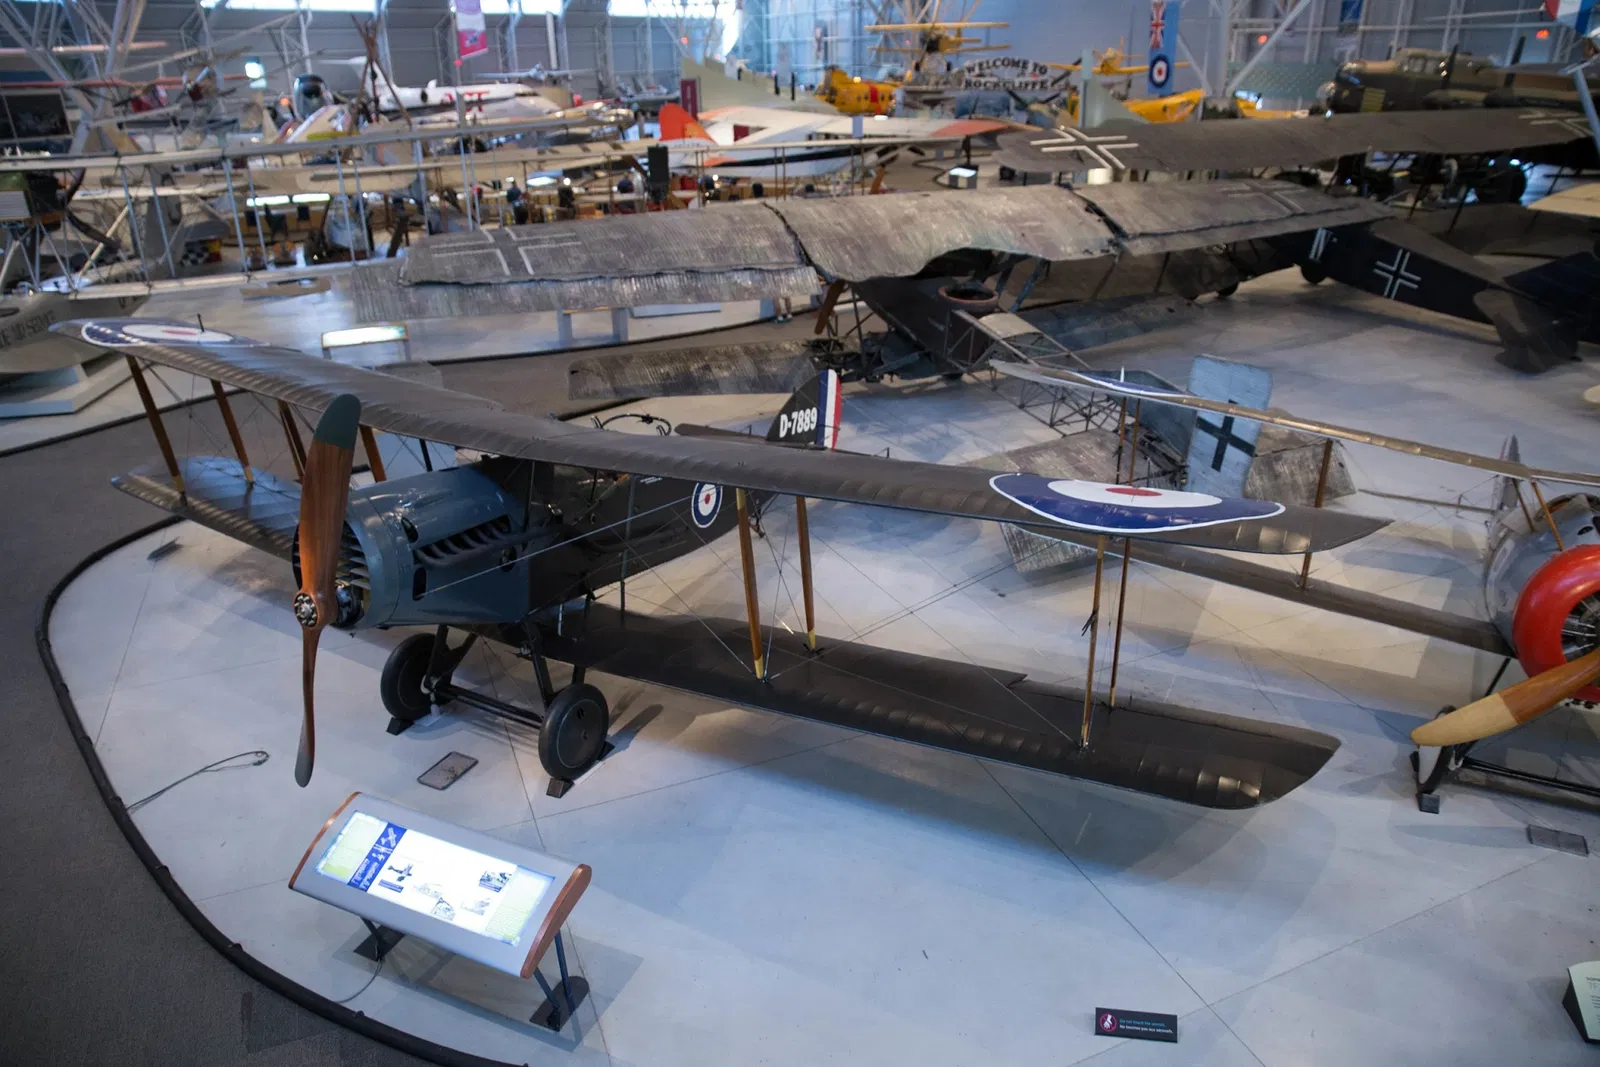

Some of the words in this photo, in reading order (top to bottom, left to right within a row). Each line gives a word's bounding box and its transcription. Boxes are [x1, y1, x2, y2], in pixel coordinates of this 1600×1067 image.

[965, 57, 1029, 74] WELCOME
[1033, 61, 1048, 75] TO
[964, 79, 1048, 90] ROCKCLIFFE
[779, 407, 818, 438] D-7889
